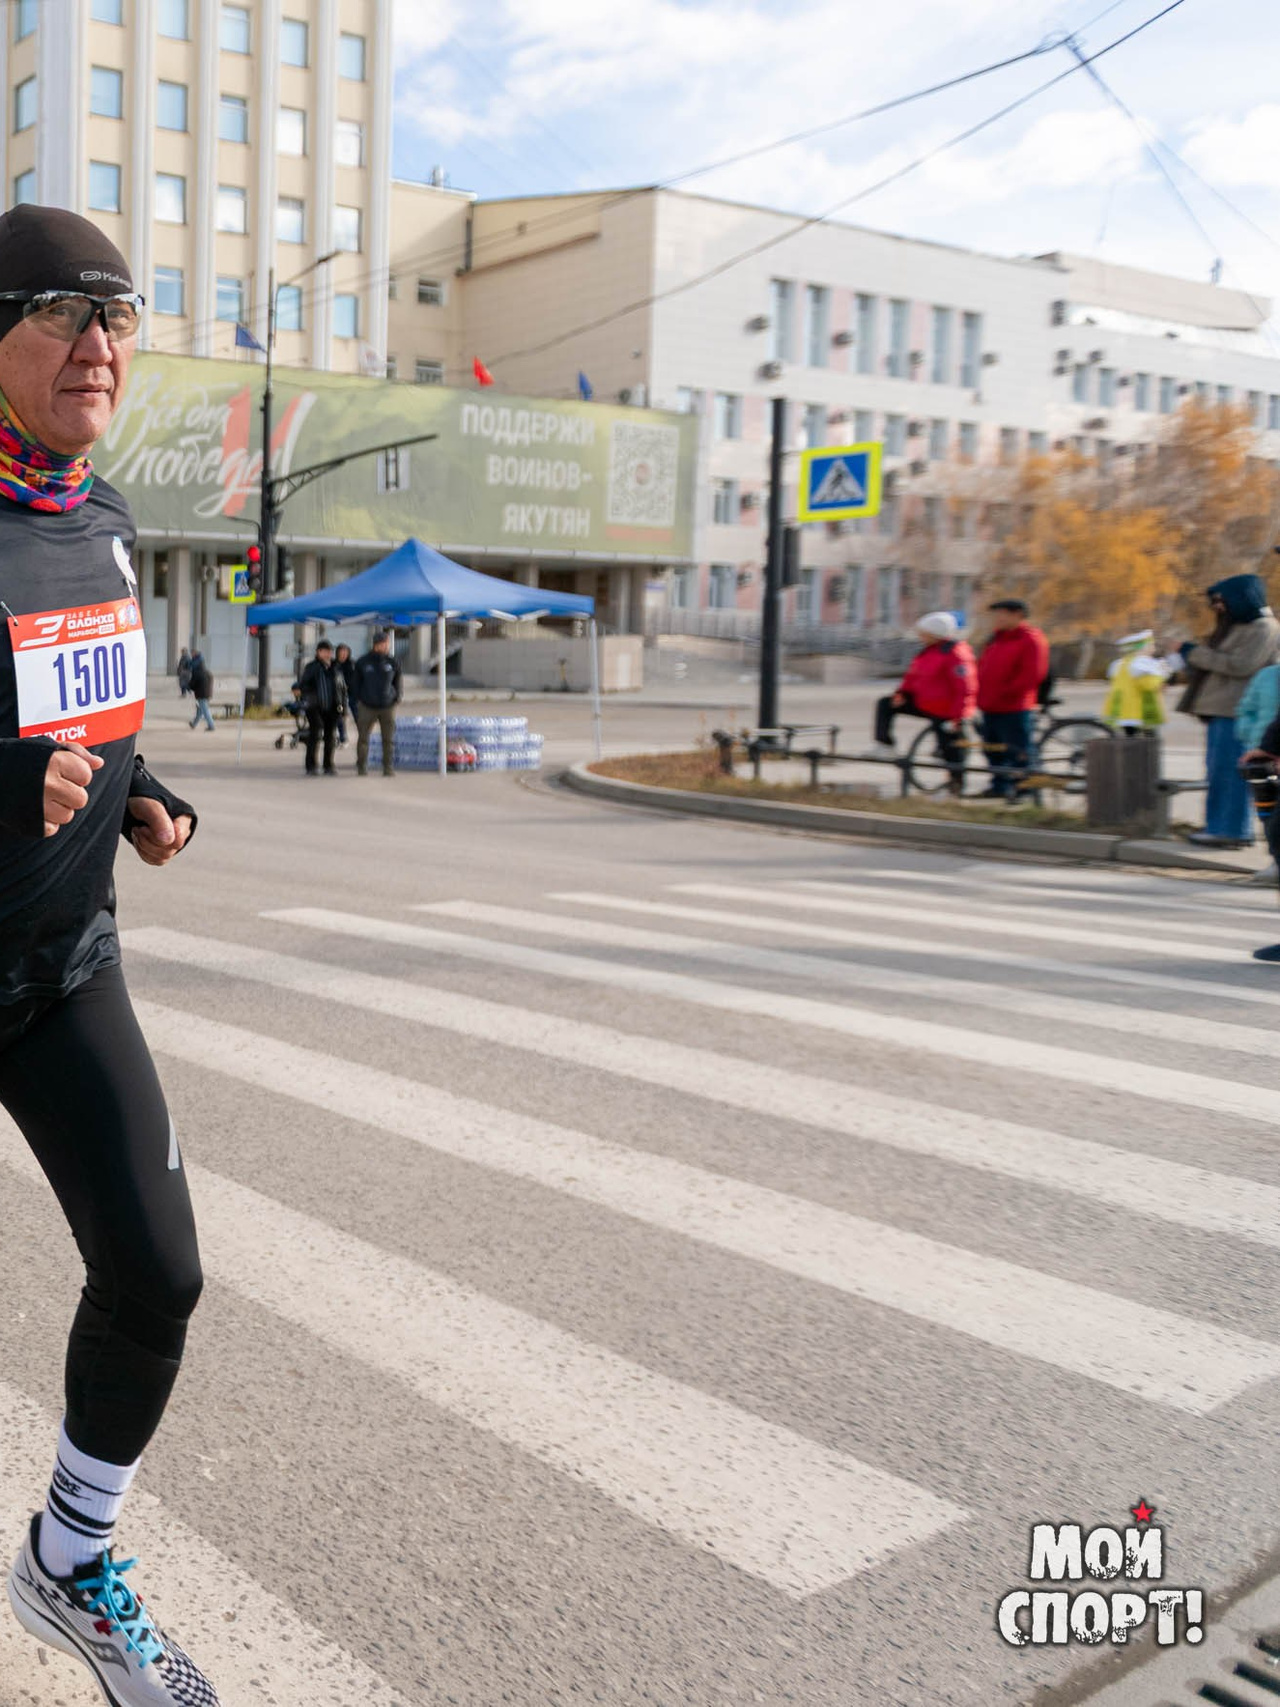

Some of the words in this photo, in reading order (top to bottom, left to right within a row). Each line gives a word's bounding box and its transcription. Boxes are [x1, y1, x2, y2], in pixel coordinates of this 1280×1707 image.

[461, 404, 596, 447] ПОДДЕРЖИ
[487, 454, 593, 491] ВОИНОВ-
[503, 502, 591, 537] ЯКУТЯН
[67, 613, 115, 630] ОЛОНХО
[53, 641, 127, 711] 1500
[31, 724, 88, 742] УТСК
